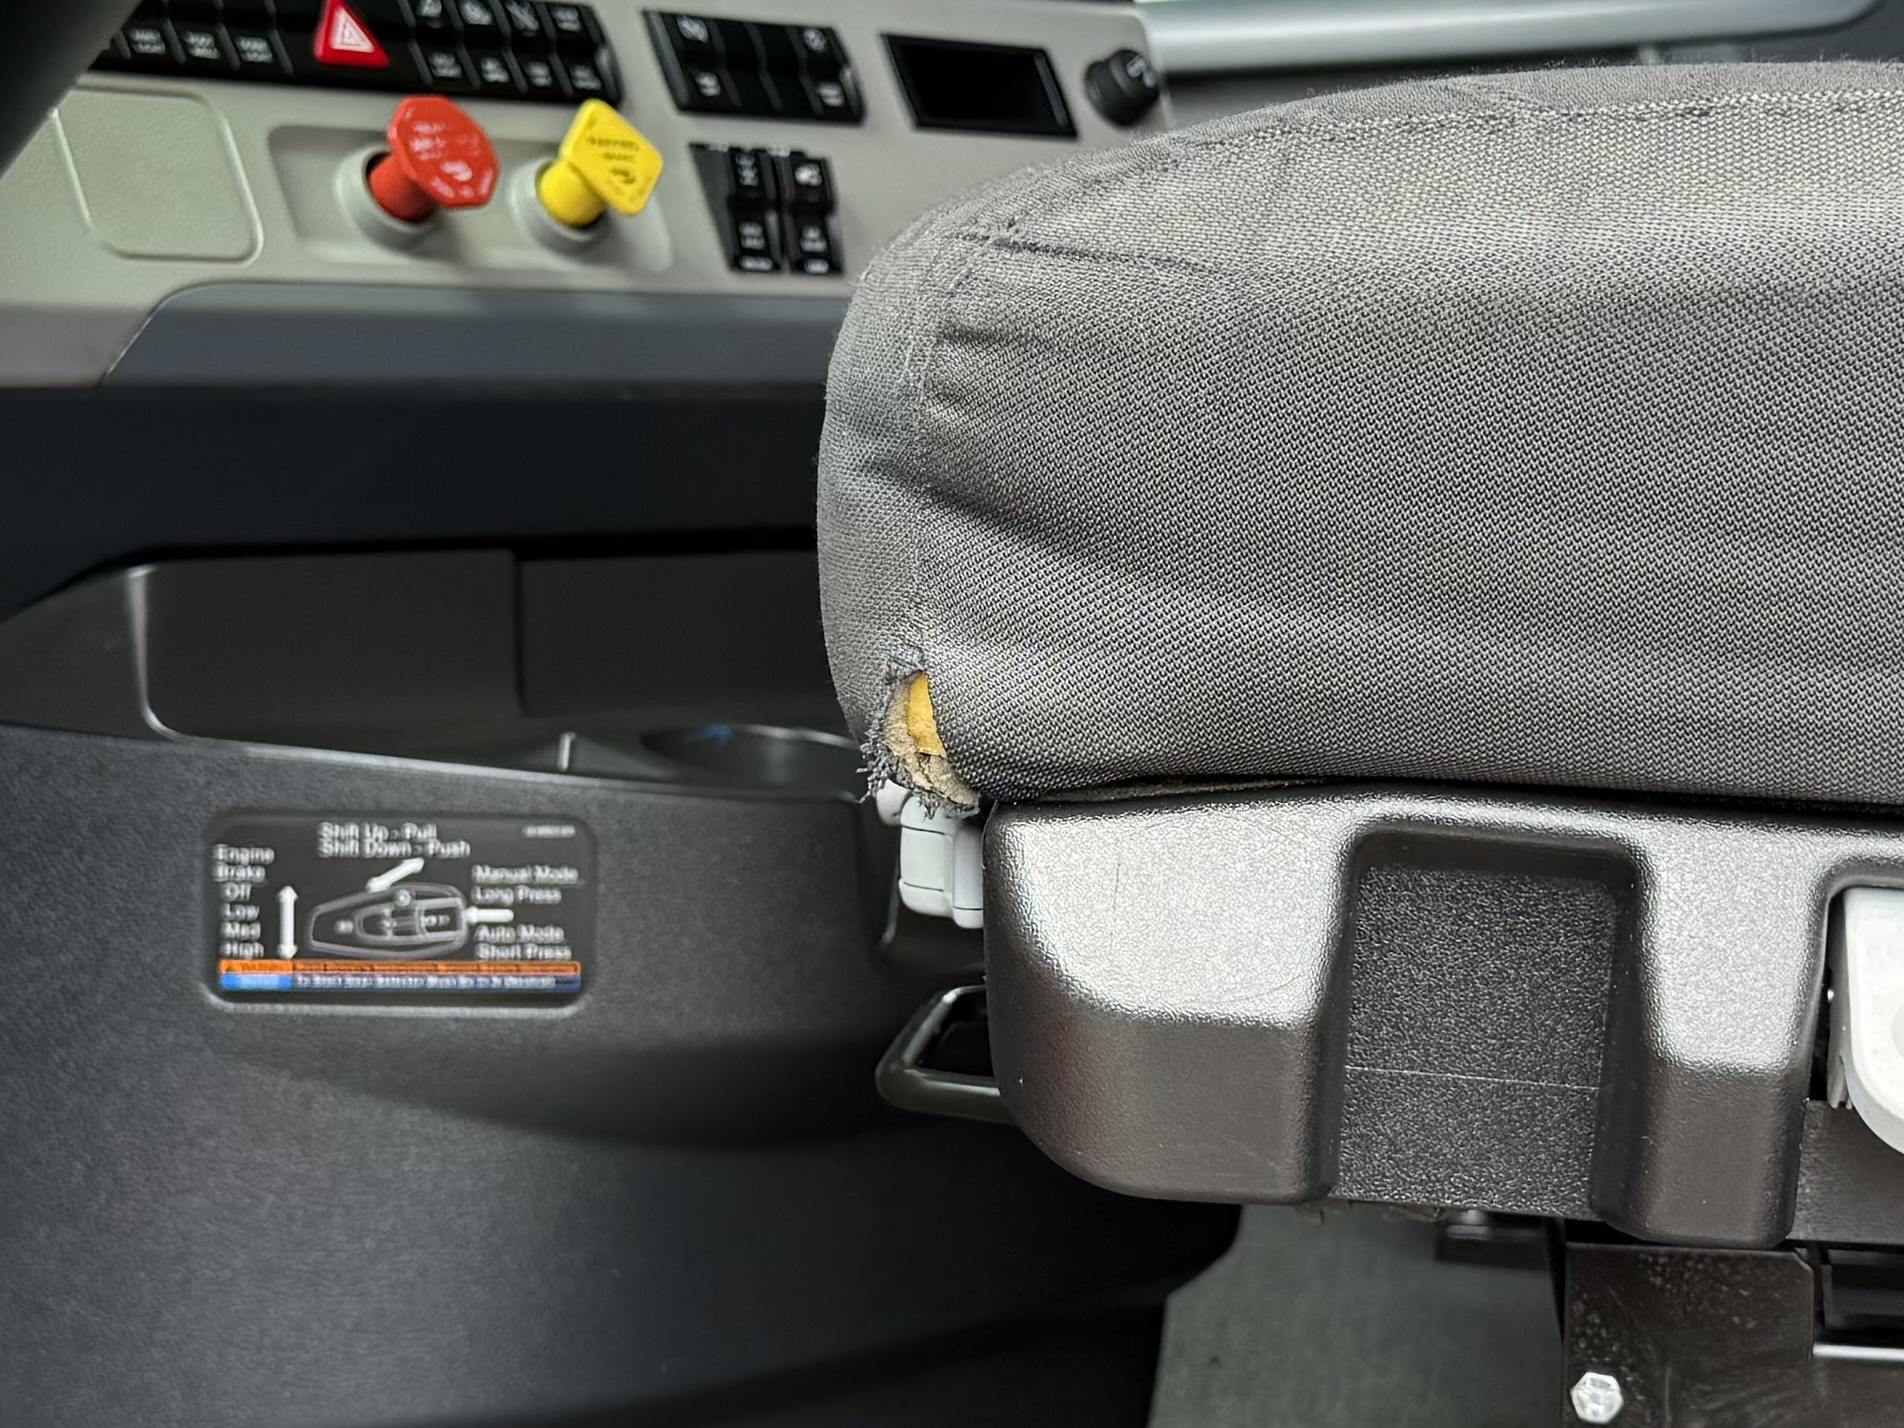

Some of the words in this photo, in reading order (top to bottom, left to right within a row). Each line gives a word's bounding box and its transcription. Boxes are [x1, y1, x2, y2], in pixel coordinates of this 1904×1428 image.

[317, 822, 360, 840] Shift
[361, 822, 389, 842] Up
[401, 822, 437, 840] Pull
[213, 843, 275, 865] Engine
[317, 839, 360, 858] Shift
[361, 839, 412, 858] Down
[425, 839, 471, 859] Push
[212, 862, 266, 884] Brake
[471, 865, 532, 884] Manual
[534, 865, 579, 884] Mode
[222, 882, 252, 902] Off
[471, 886, 514, 906] Long
[516, 885, 562, 905] Press
[221, 904, 260, 921] Low
[221, 922, 262, 940] Med
[475, 924, 516, 943] Auto
[517, 924, 565, 943] Mode
[220, 942, 265, 961] High
[475, 943, 522, 960] Short
[524, 943, 573, 960] Press
